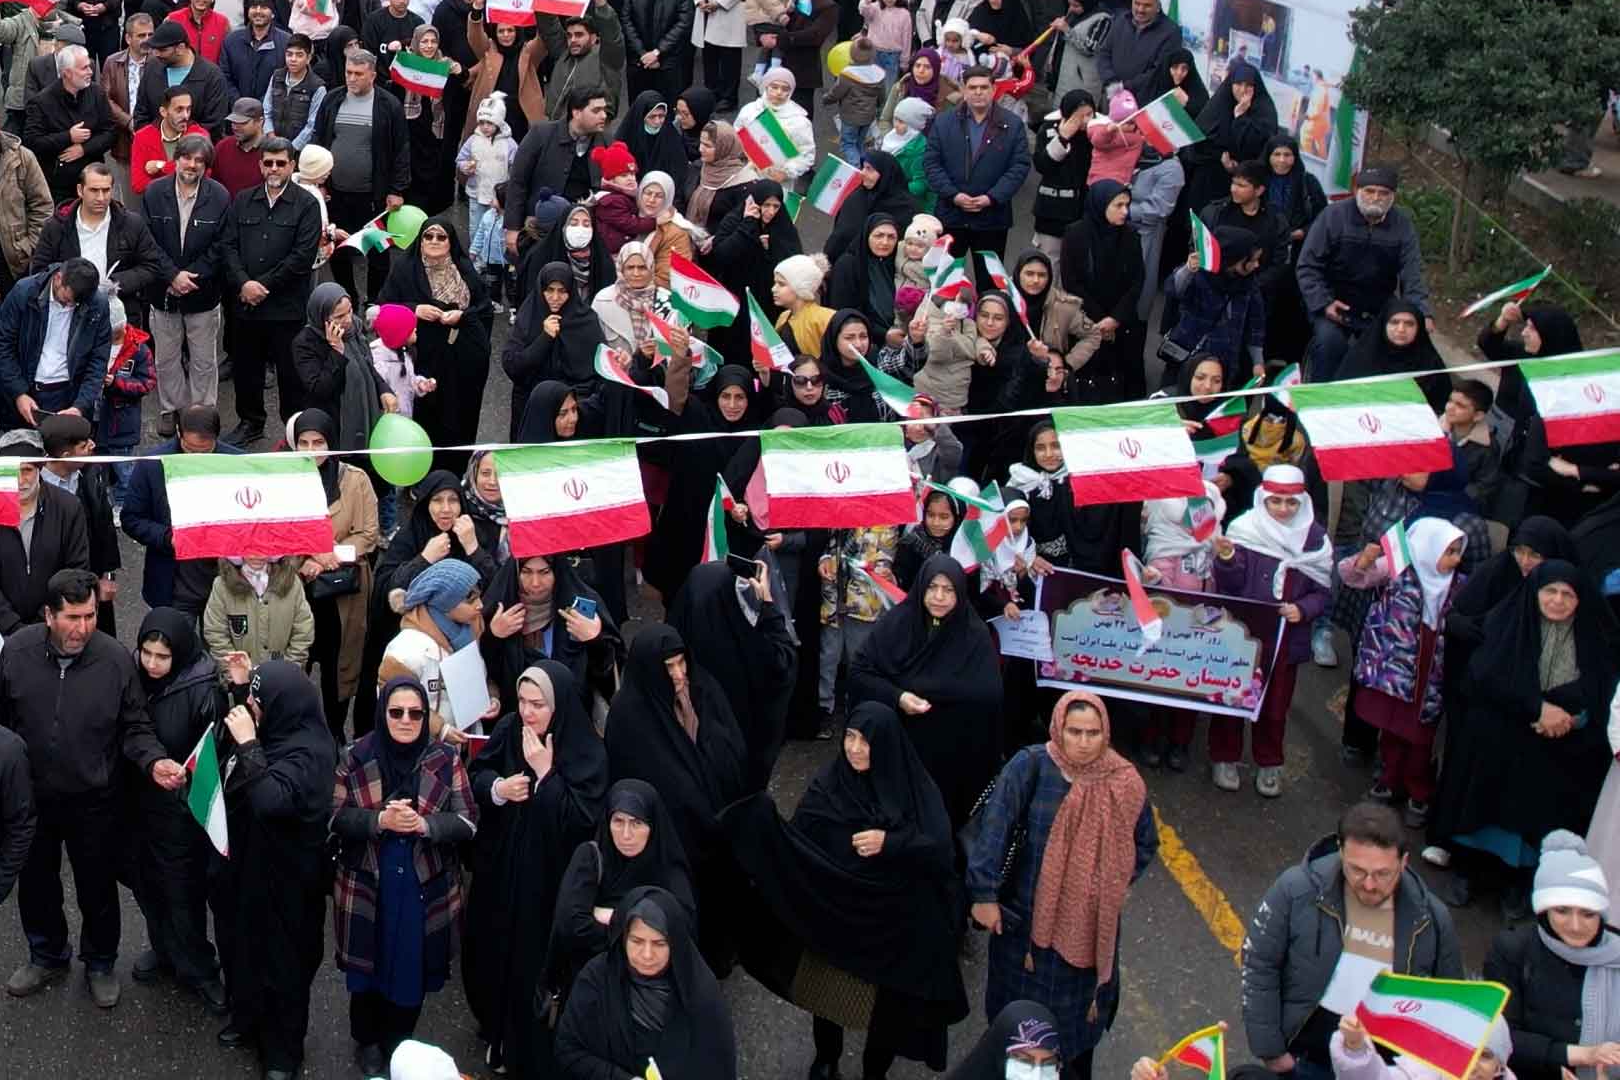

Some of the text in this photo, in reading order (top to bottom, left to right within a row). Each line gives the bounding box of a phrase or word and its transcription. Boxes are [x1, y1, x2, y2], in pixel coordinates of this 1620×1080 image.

[1070, 652, 1124, 671] خدیجه
[1128, 660, 1181, 681] حضرت
[1186, 666, 1242, 689] دبستان
